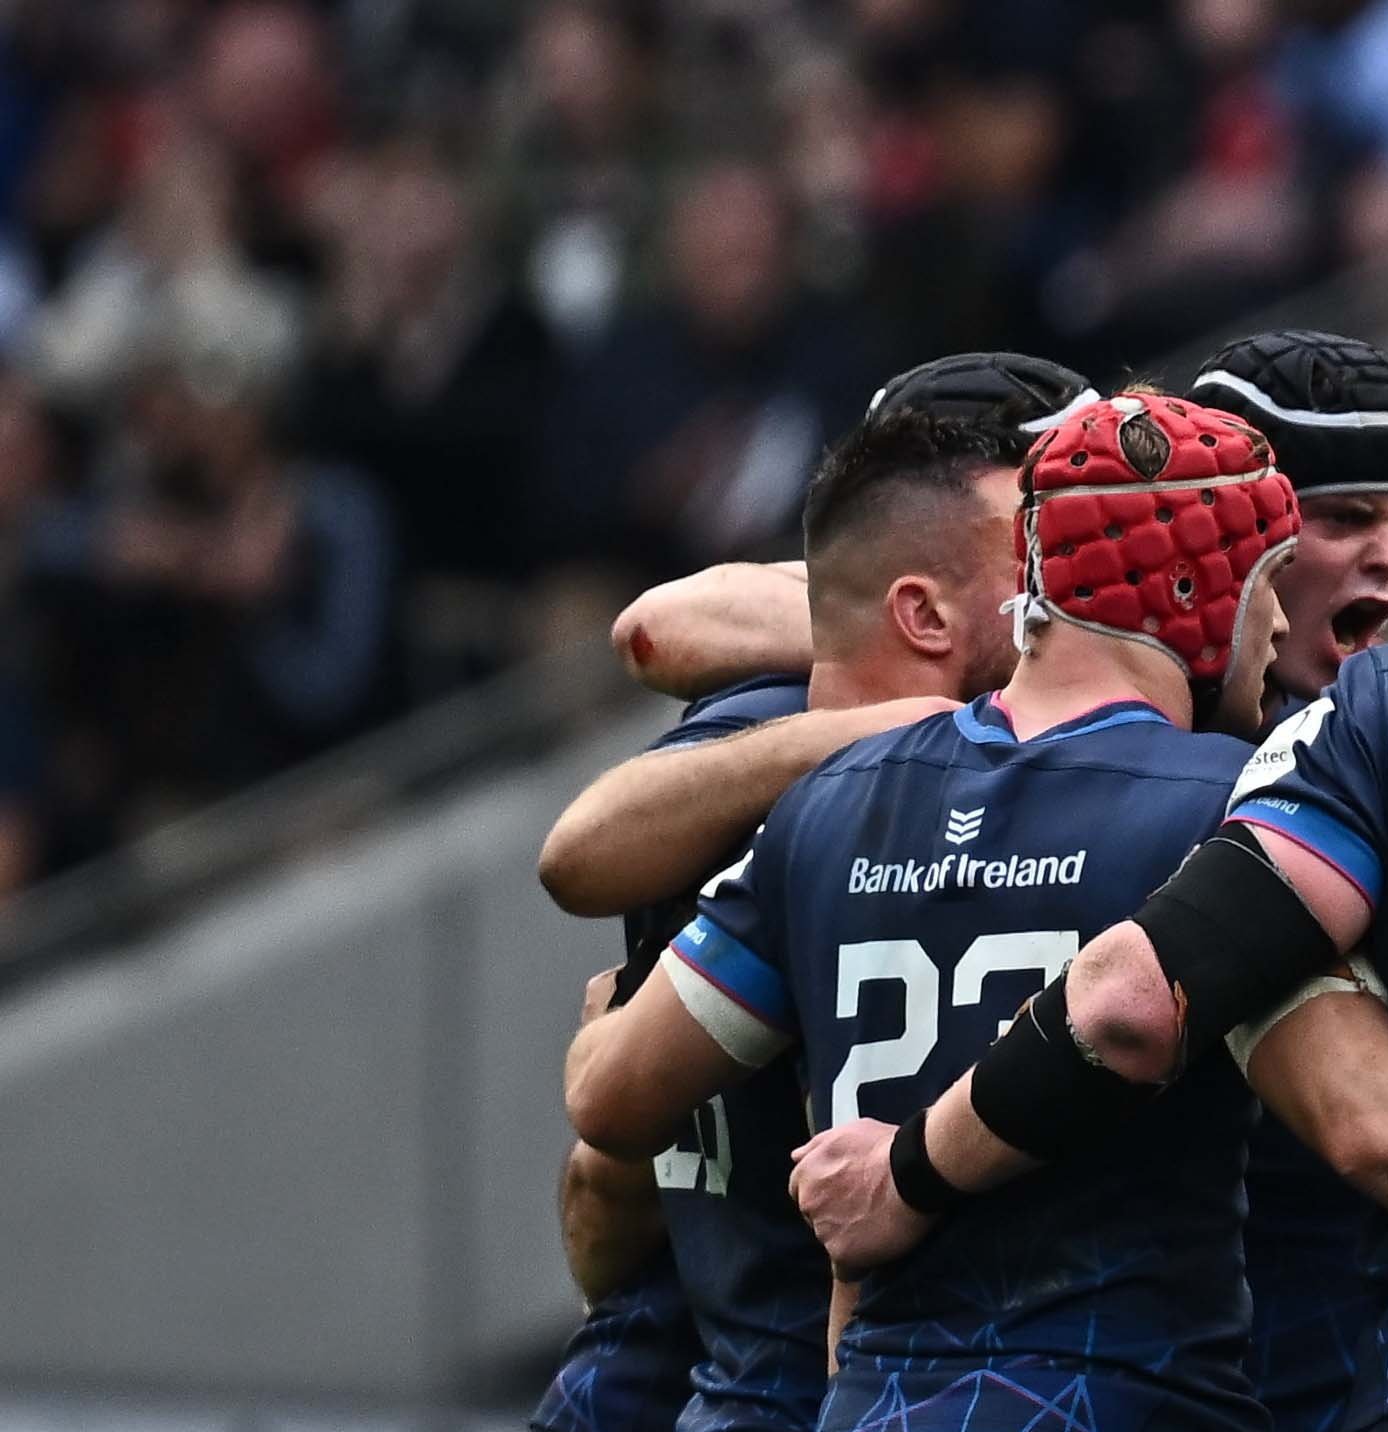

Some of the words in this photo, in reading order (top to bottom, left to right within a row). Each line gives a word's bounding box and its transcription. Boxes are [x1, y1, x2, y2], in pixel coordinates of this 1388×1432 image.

[849, 857, 925, 893] Bank
[923, 854, 955, 891] of
[956, 850, 1086, 889] Ireland
